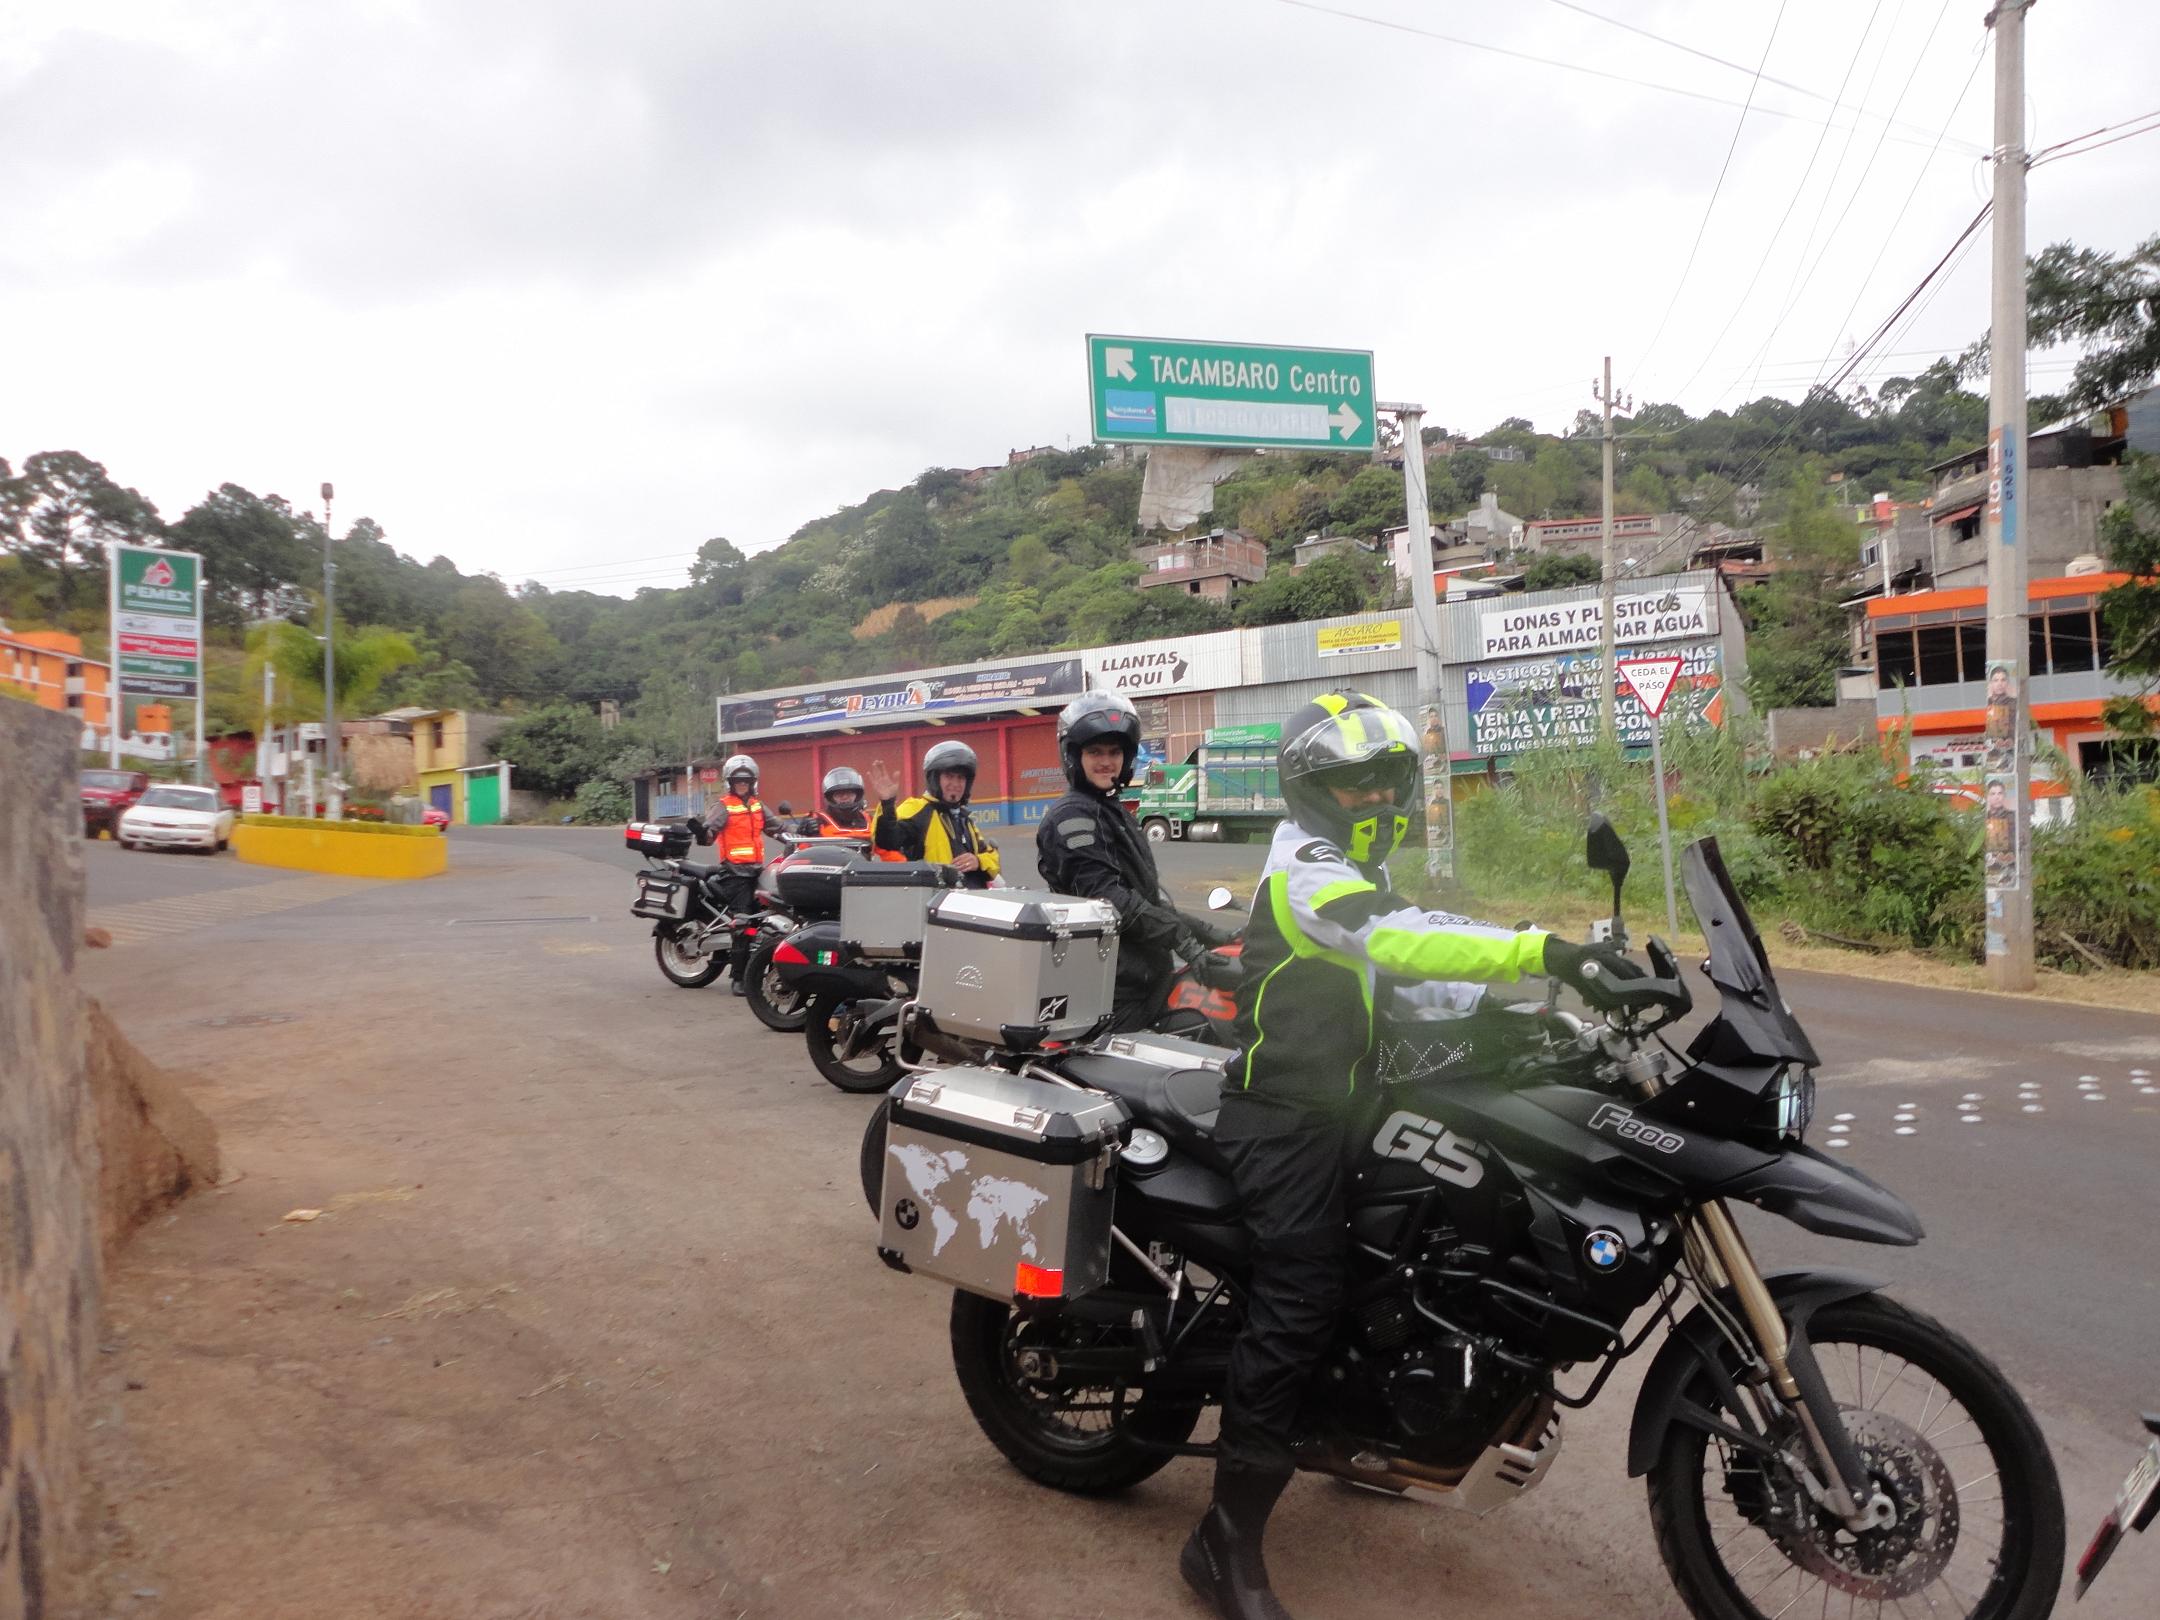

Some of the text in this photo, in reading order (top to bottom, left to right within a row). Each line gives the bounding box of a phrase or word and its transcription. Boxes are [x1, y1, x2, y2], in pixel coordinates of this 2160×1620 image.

[1150, 355, 1361, 397] TACAMBARO Centro
[124, 584, 192, 603] PEMEX
[1504, 593, 1682, 633] LONAS Y PLSTICOS
[1486, 634, 1532, 654] PARA
[1653, 613, 1704, 634] AGUA
[1101, 651, 1178, 672] LLANTAS
[1467, 662, 1552, 684] PLASTICOS
[1631, 667, 1670, 677] CEDA EL
[1116, 672, 1163, 688] AQUI
[847, 688, 924, 713] REYBRA
[1473, 709, 1530, 728] VENTA
[1533, 708, 1546, 722] Y
[1537, 722, 1551, 737] Y
[1168, 980, 1238, 1021] GS
[1588, 1102, 1685, 1154] F800
[1372, 1110, 1489, 1189] GS
